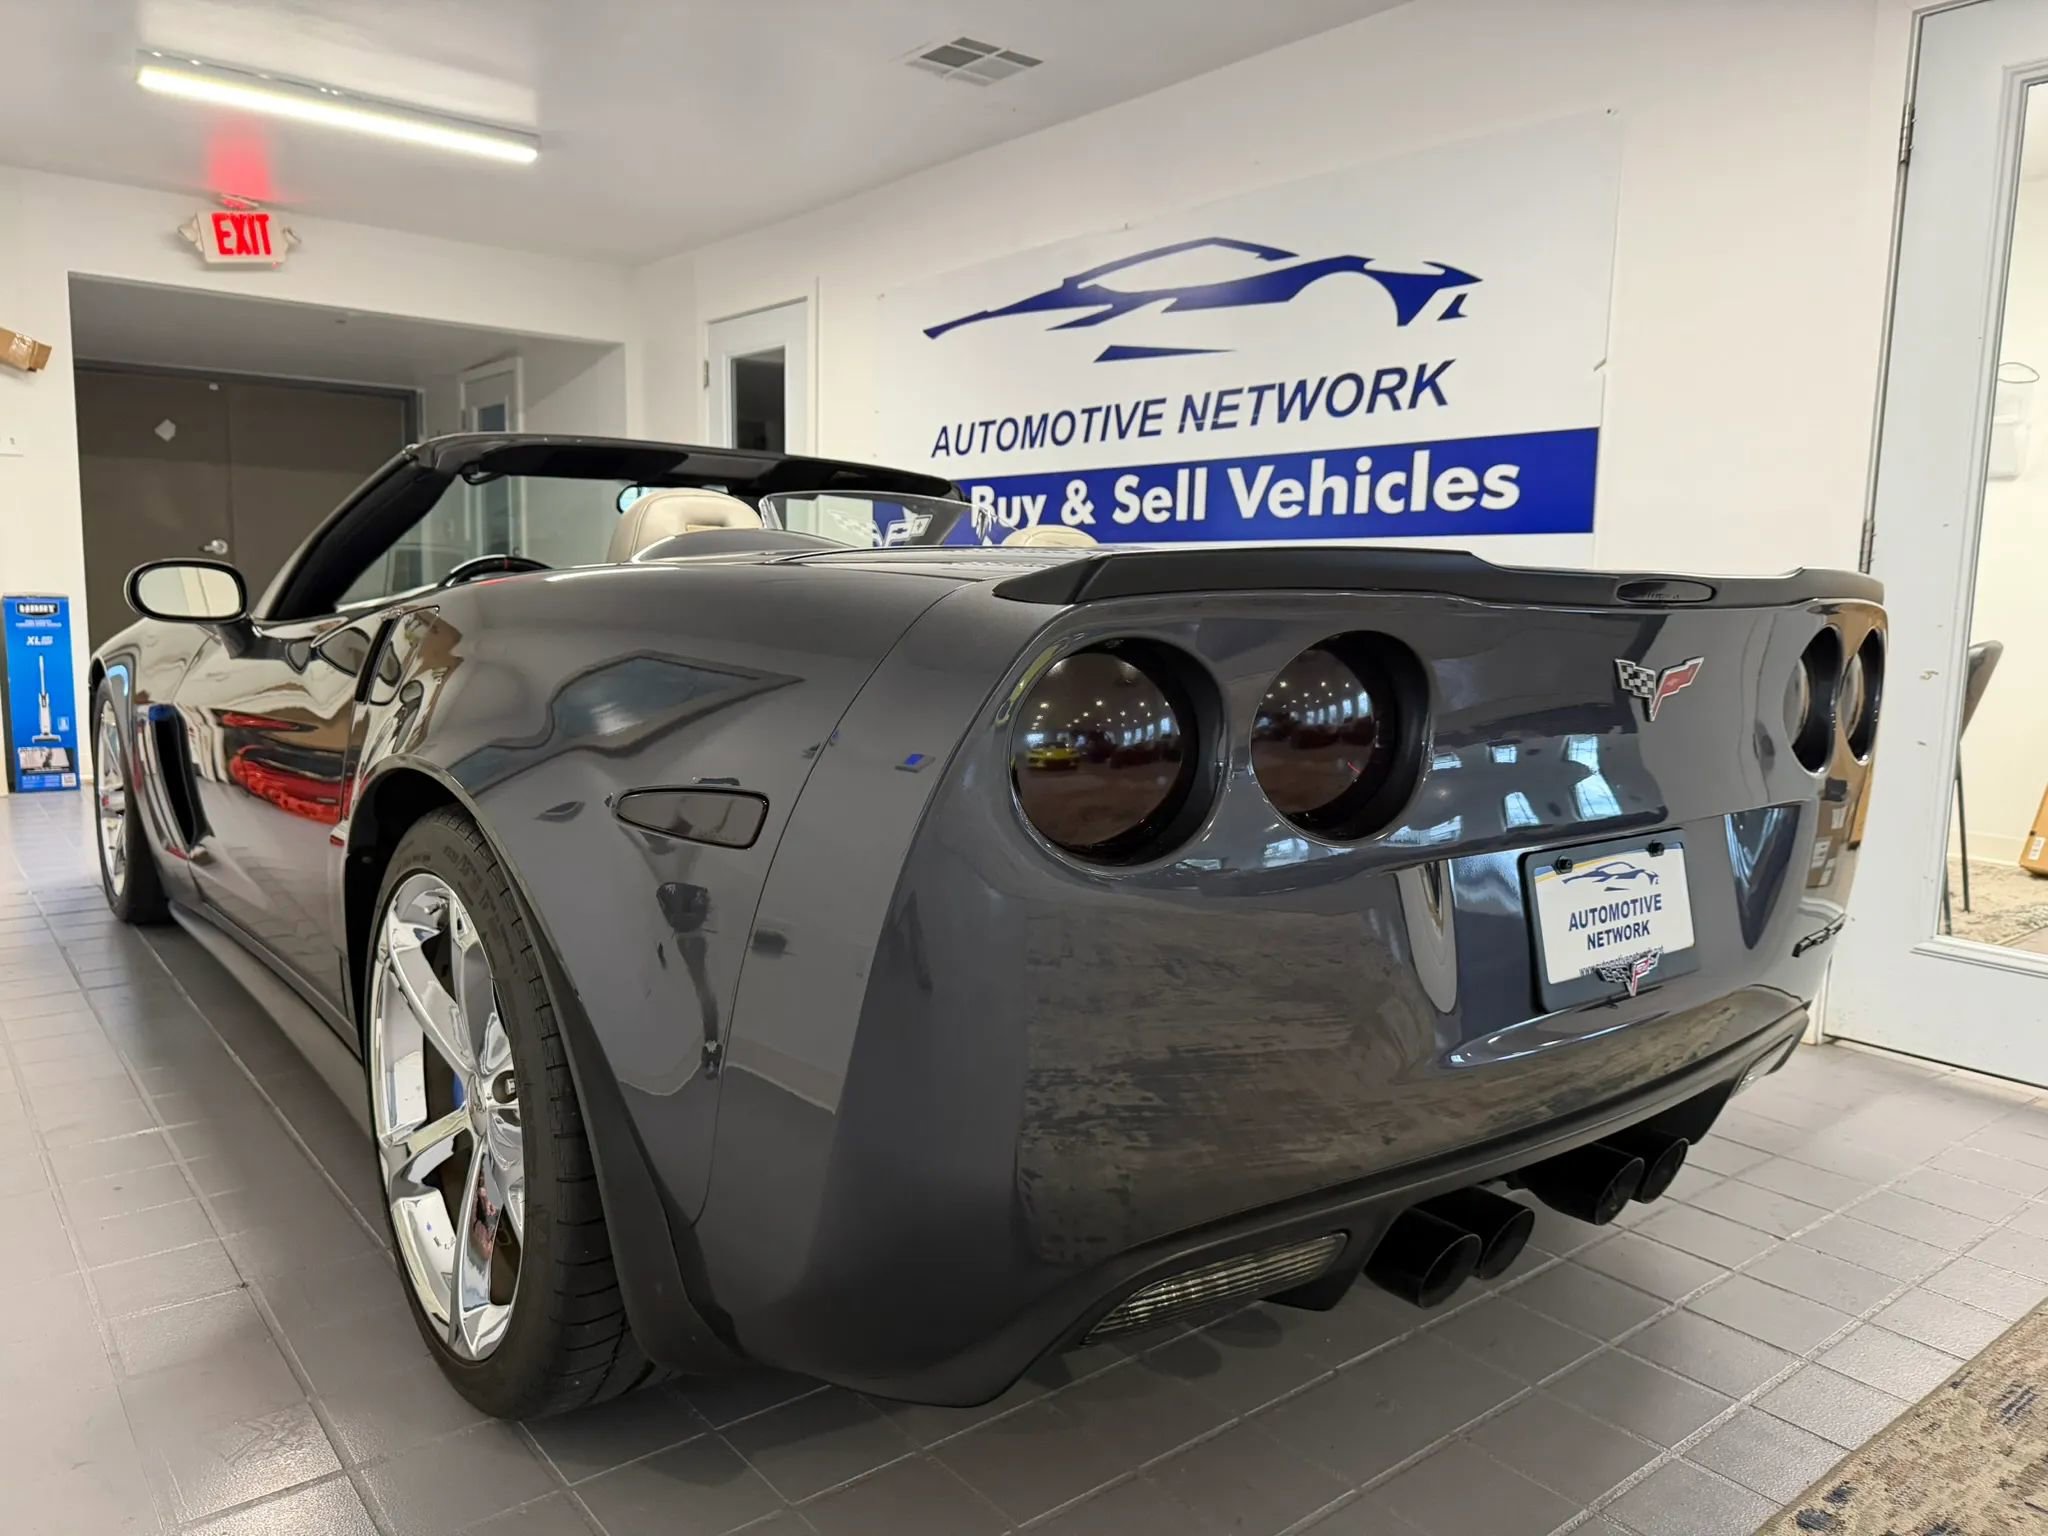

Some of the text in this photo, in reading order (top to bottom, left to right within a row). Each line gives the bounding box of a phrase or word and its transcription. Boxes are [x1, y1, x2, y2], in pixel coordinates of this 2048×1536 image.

[211, 212, 272, 256] EXIT
[931, 359, 1456, 458] AUTOMOTIVE NETWORK
[970, 449, 1521, 530] Buy & Sell Vehicles
[1568, 893, 1662, 932] AUTOMOTIVE
[1587, 919, 1651, 950] NETWORK
